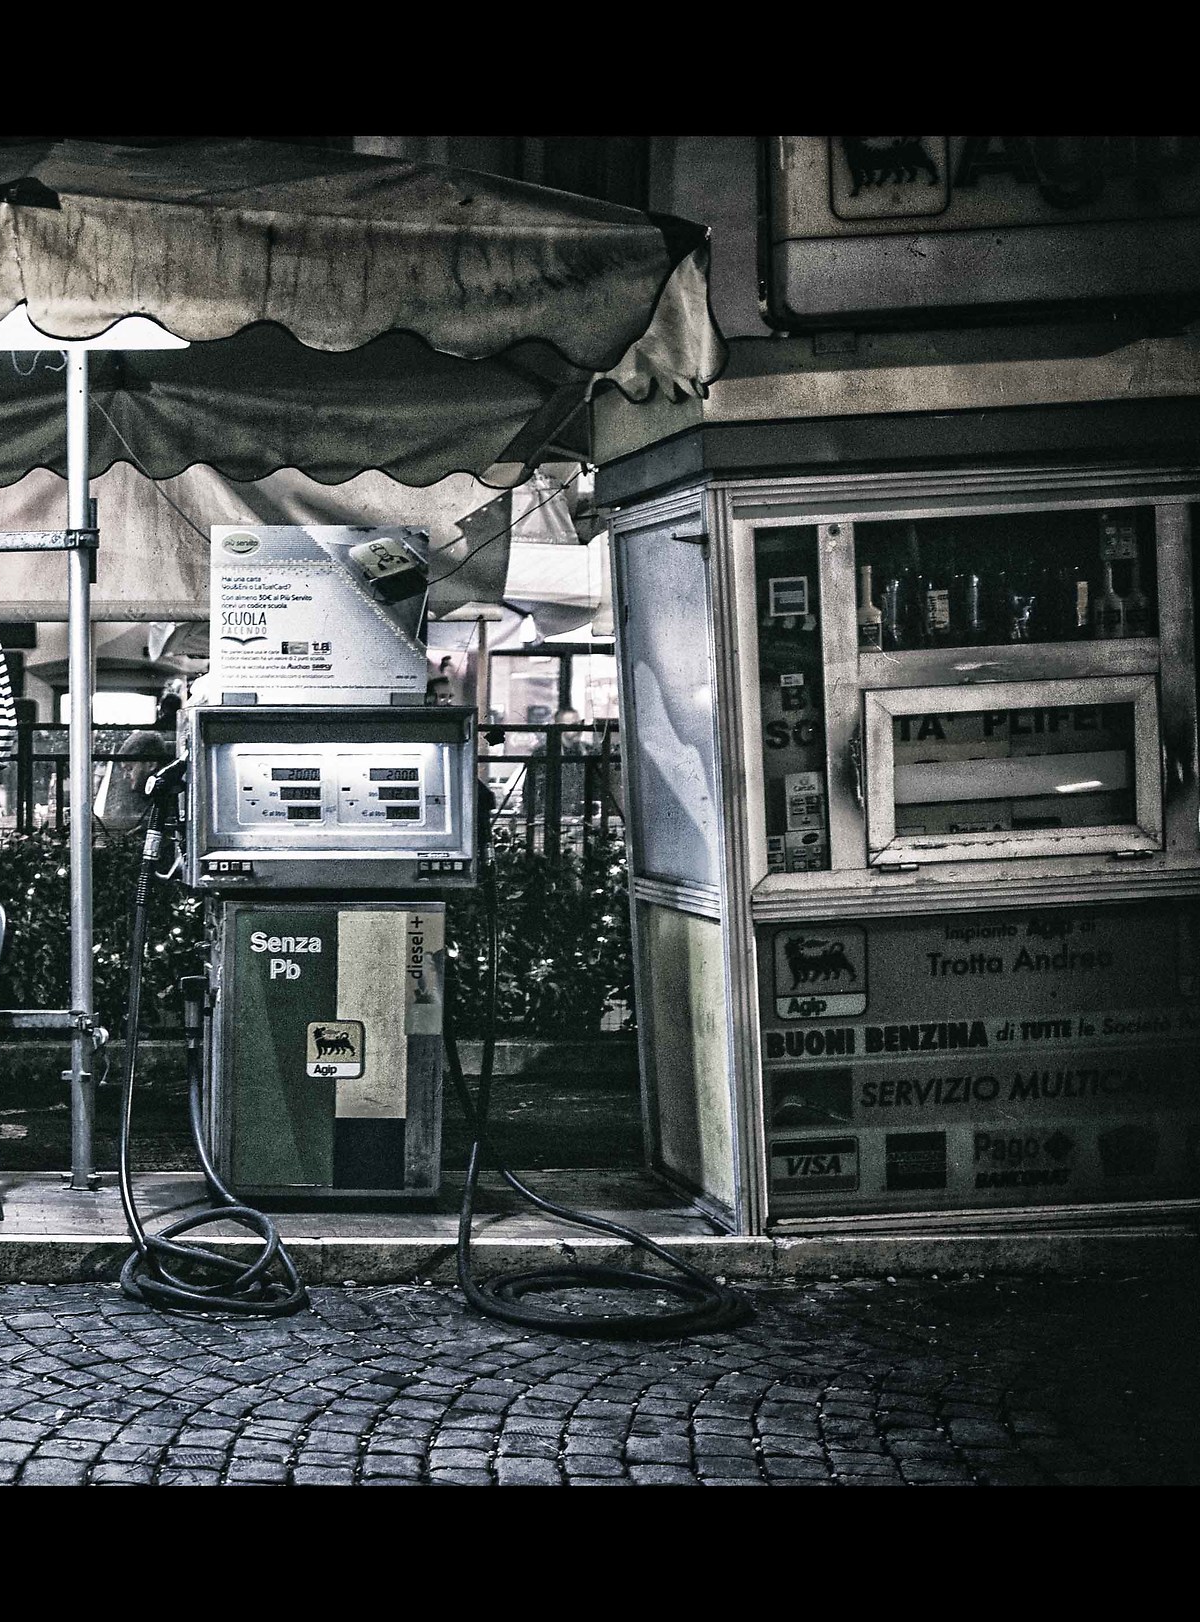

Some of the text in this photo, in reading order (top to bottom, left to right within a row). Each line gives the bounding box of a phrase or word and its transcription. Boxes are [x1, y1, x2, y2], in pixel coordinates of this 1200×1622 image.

[221, 611, 267, 626] SCUOLA
[221, 626, 267, 635] FACENDO
[250, 931, 323, 953] Senza
[945, 922, 1018, 942] Impianto
[269, 958, 302, 980] Pb
[927, 943, 1113, 976] Trotta Andrea
[788, 997, 827, 1017] Agip
[766, 1028, 855, 1058] BUONI
[865, 1021, 988, 1053] BENZINA
[996, 1021, 1015, 1041] di
[1020, 1019, 1071, 1040] TUTTE
[1079, 1018, 1095, 1037] le
[313, 1064, 337, 1076] Agip
[861, 1076, 1000, 1107] SERVIZIO
[974, 1133, 1040, 1166] Pago
[787, 1155, 842, 1176] VISA
